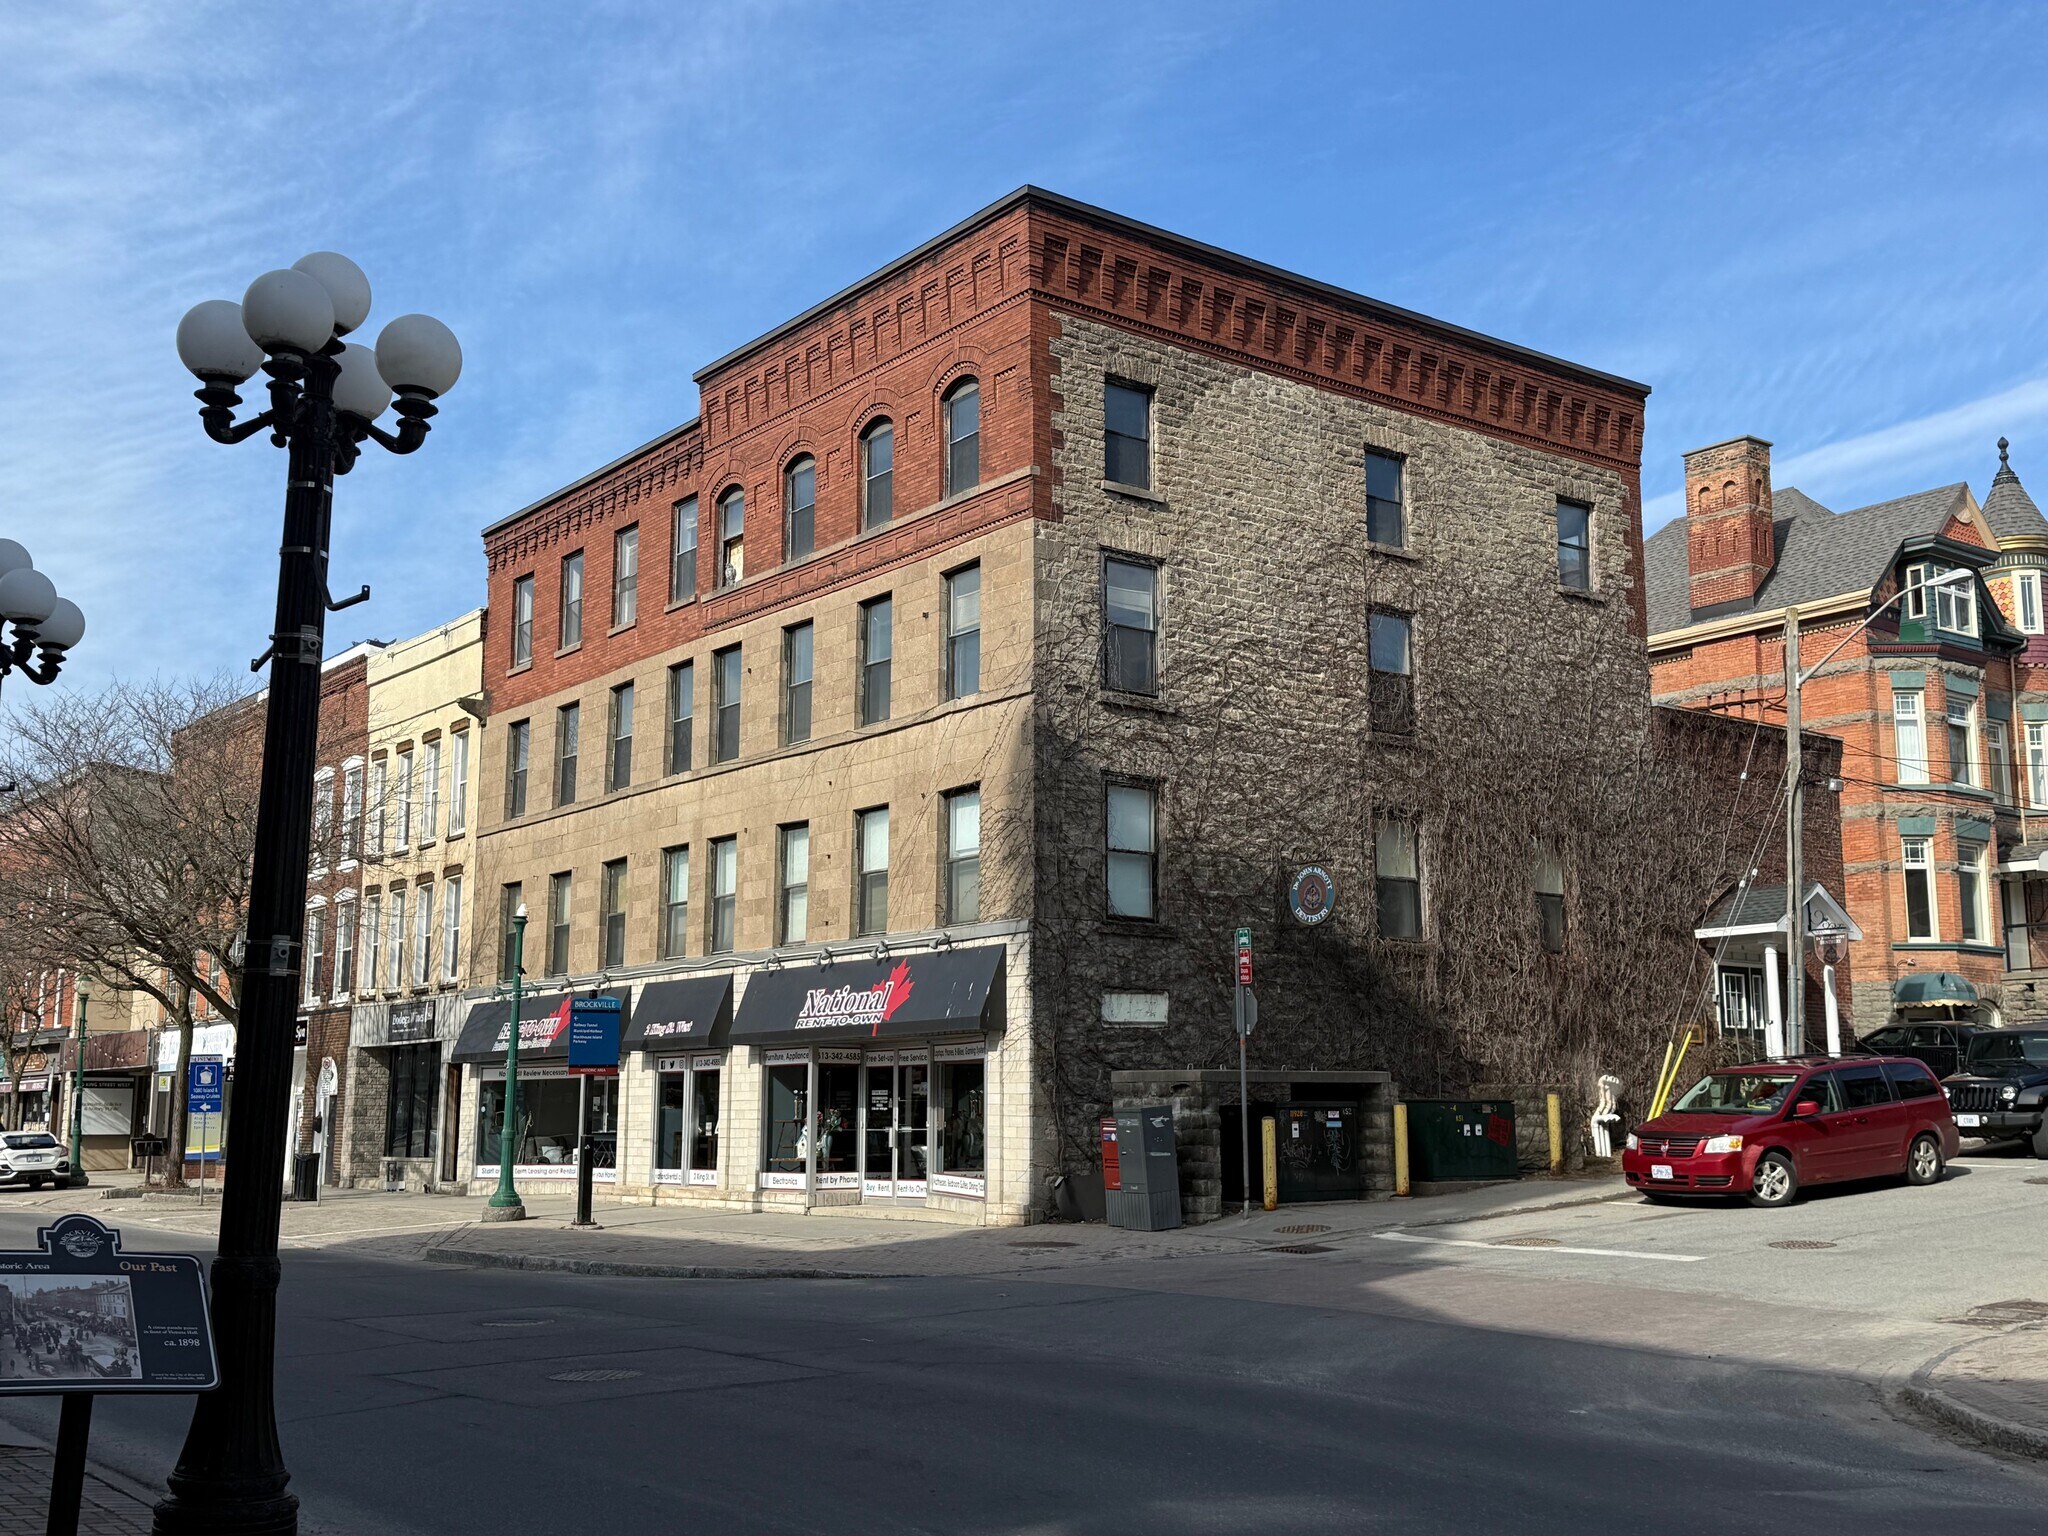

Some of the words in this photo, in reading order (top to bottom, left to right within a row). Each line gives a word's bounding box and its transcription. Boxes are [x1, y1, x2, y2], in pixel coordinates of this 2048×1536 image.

[1297, 866, 1312, 881] JOHN
[1313, 867, 1332, 889] ARNOTT
[1295, 907, 1328, 922] DENTISTRY
[799, 981, 894, 1017] National
[795, 1012, 884, 1029] RENT-TO-OWN
[866, 1054, 877, 1062] Free
[877, 1054, 894, 1063] Set-up
[899, 1053, 910, 1062] Free
[910, 1053, 927, 1061] Service
[523, 1069, 541, 1077] Review
[542, 1069, 568, 1077] Necessary
[528, 1167, 548, 1176] Leasing
[816, 1176, 829, 1184] Rent
[830, 1176, 838, 1185] by
[839, 1175, 858, 1184] Phone
[59, 1229, 104, 1246] BROCKVILLE
[25, 1262, 50, 1270] Area
[119, 1261, 147, 1271] Our
[150, 1262, 177, 1272] Past
[178, 1338, 200, 1346] 1898
